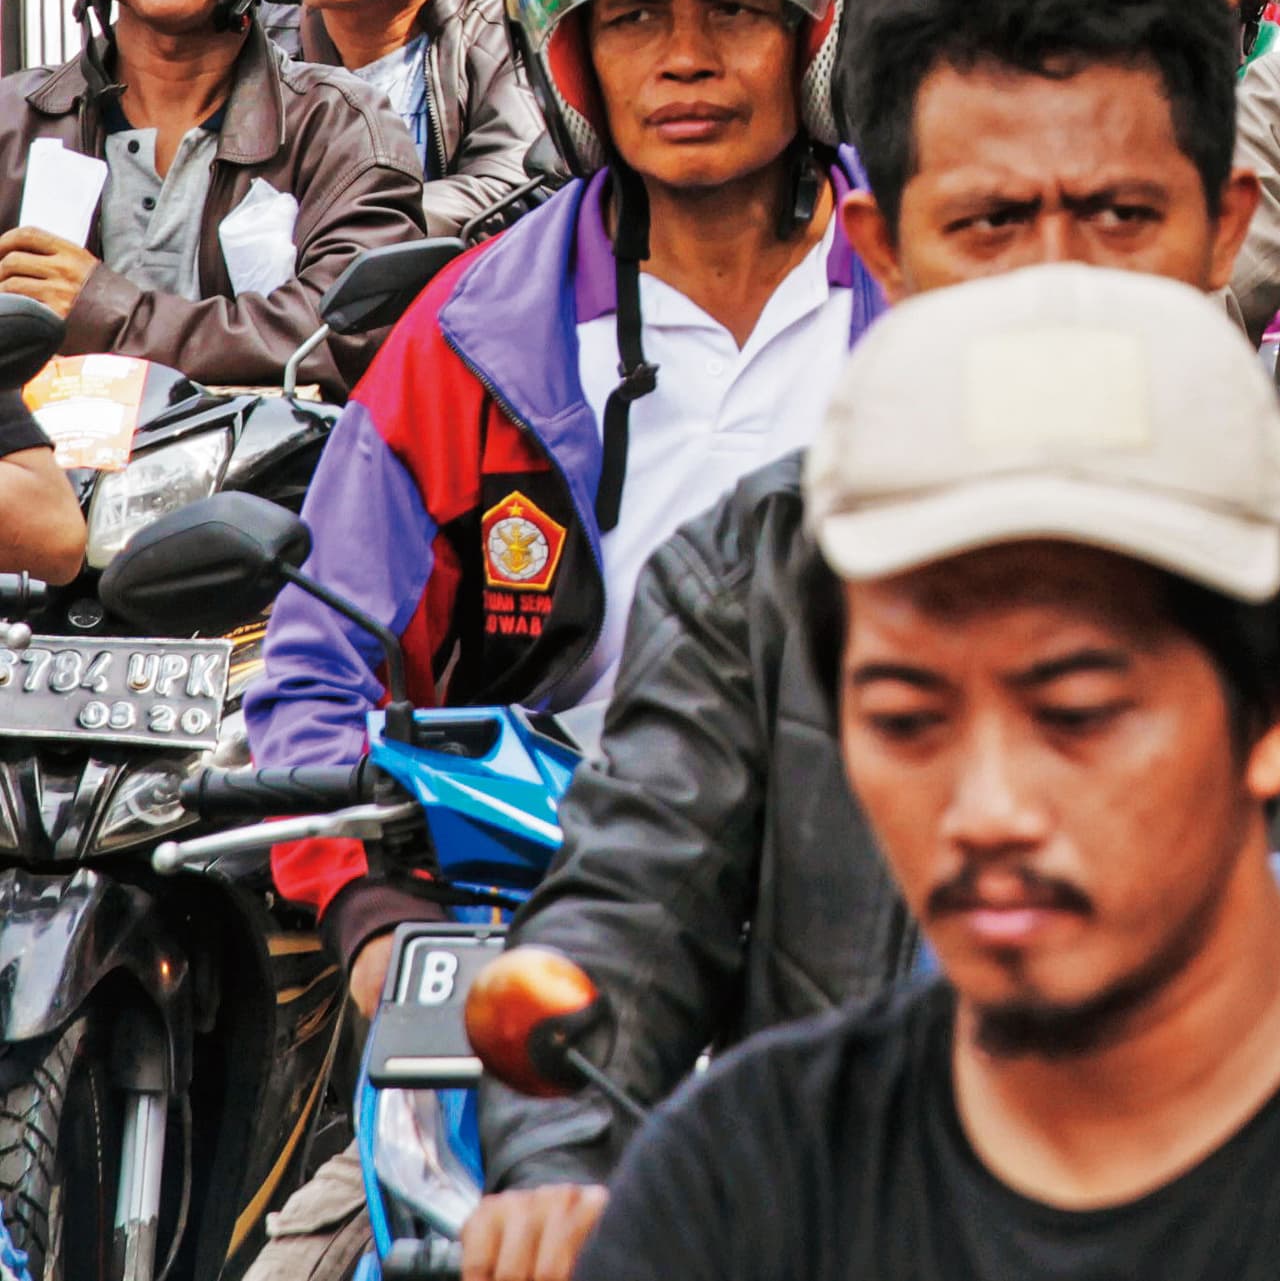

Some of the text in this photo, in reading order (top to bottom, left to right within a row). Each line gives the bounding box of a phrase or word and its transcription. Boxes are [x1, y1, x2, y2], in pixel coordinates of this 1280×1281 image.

[127, 652, 219, 697] UPK
[148, 704, 212, 735] 20
[418, 951, 458, 1006] B
